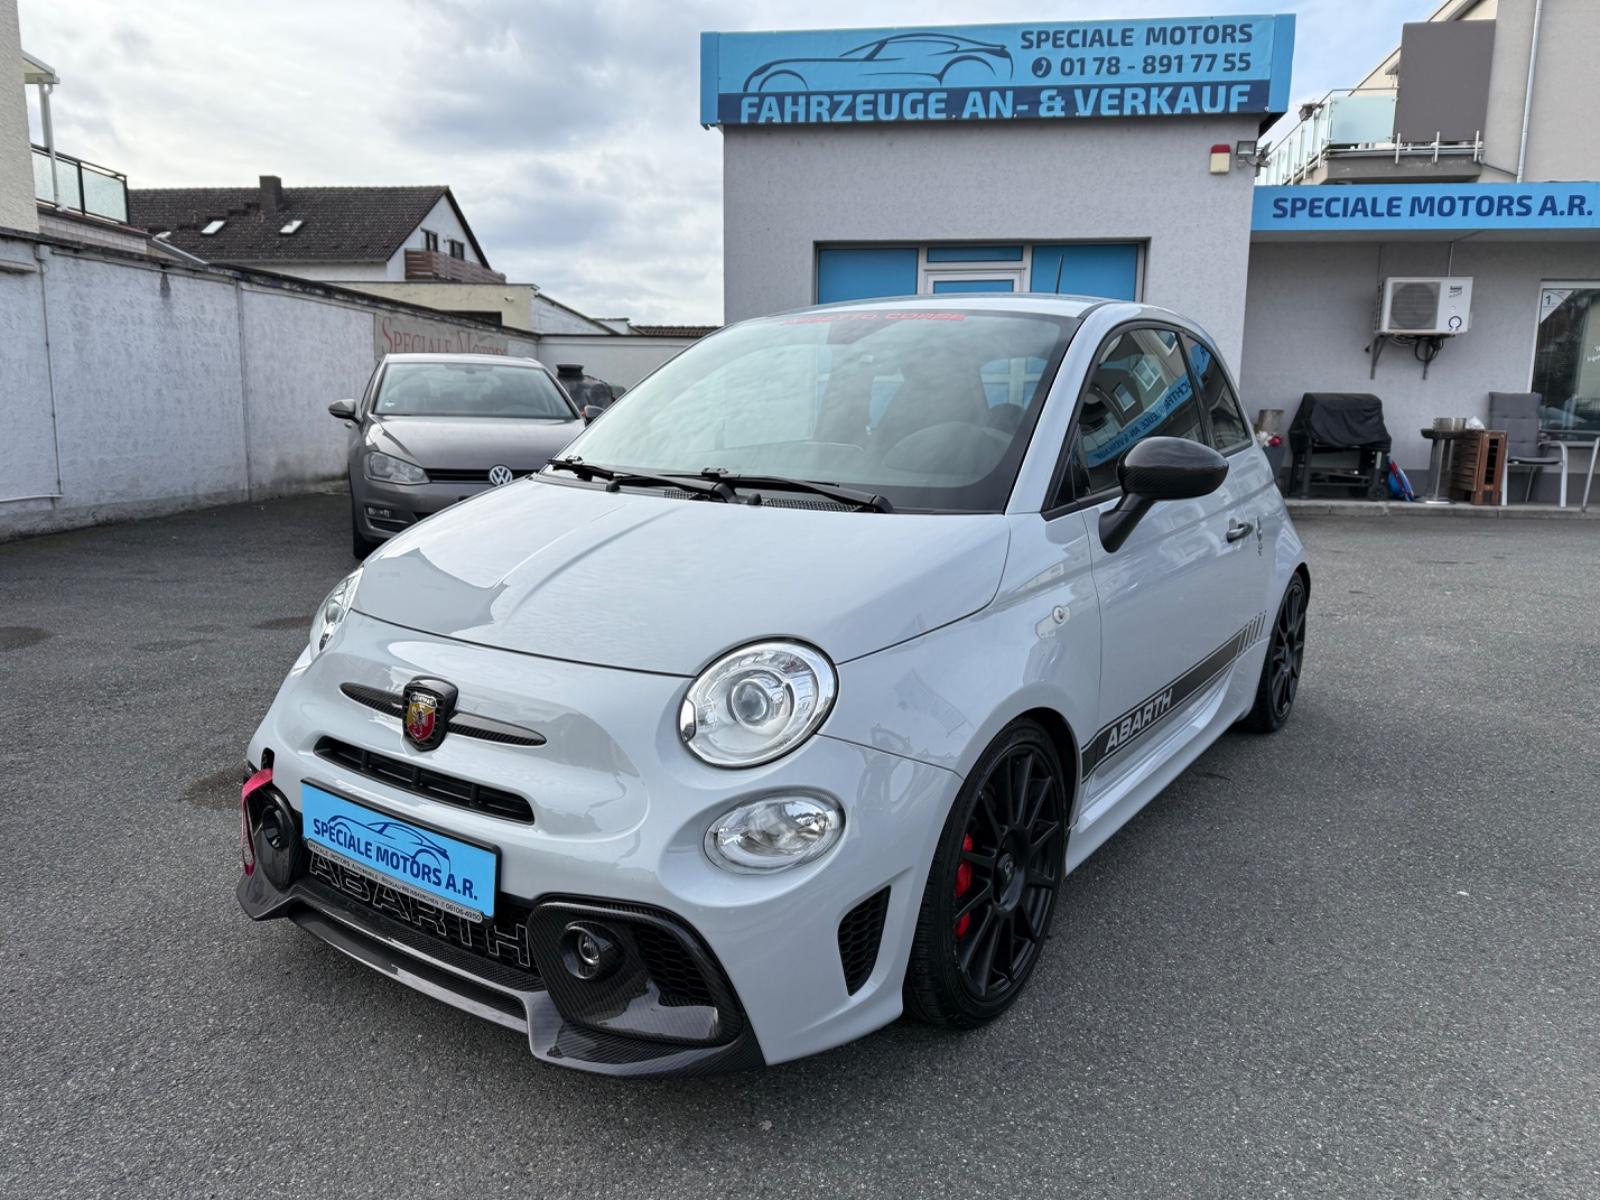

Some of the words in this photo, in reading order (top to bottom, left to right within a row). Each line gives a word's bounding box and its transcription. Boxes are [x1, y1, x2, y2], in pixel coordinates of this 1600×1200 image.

[1020, 27, 1134, 49] SPECIALE
[1145, 23, 1254, 46] MOTORS
[740, 91, 948, 124] FAHRZEUGE
[961, 90, 1029, 120] AN-
[1038, 89, 1066, 118] &
[1073, 84, 1251, 117] VERKAUF
[1272, 196, 1402, 219] SPECIALE
[1409, 194, 1533, 217] MOTORS
[1537, 194, 1593, 217] A.R.
[1105, 688, 1172, 753] ABARTH
[313, 818, 373, 859] SPECIALE
[376, 846, 442, 887] MOTORS
[445, 873, 478, 900] A.R.
